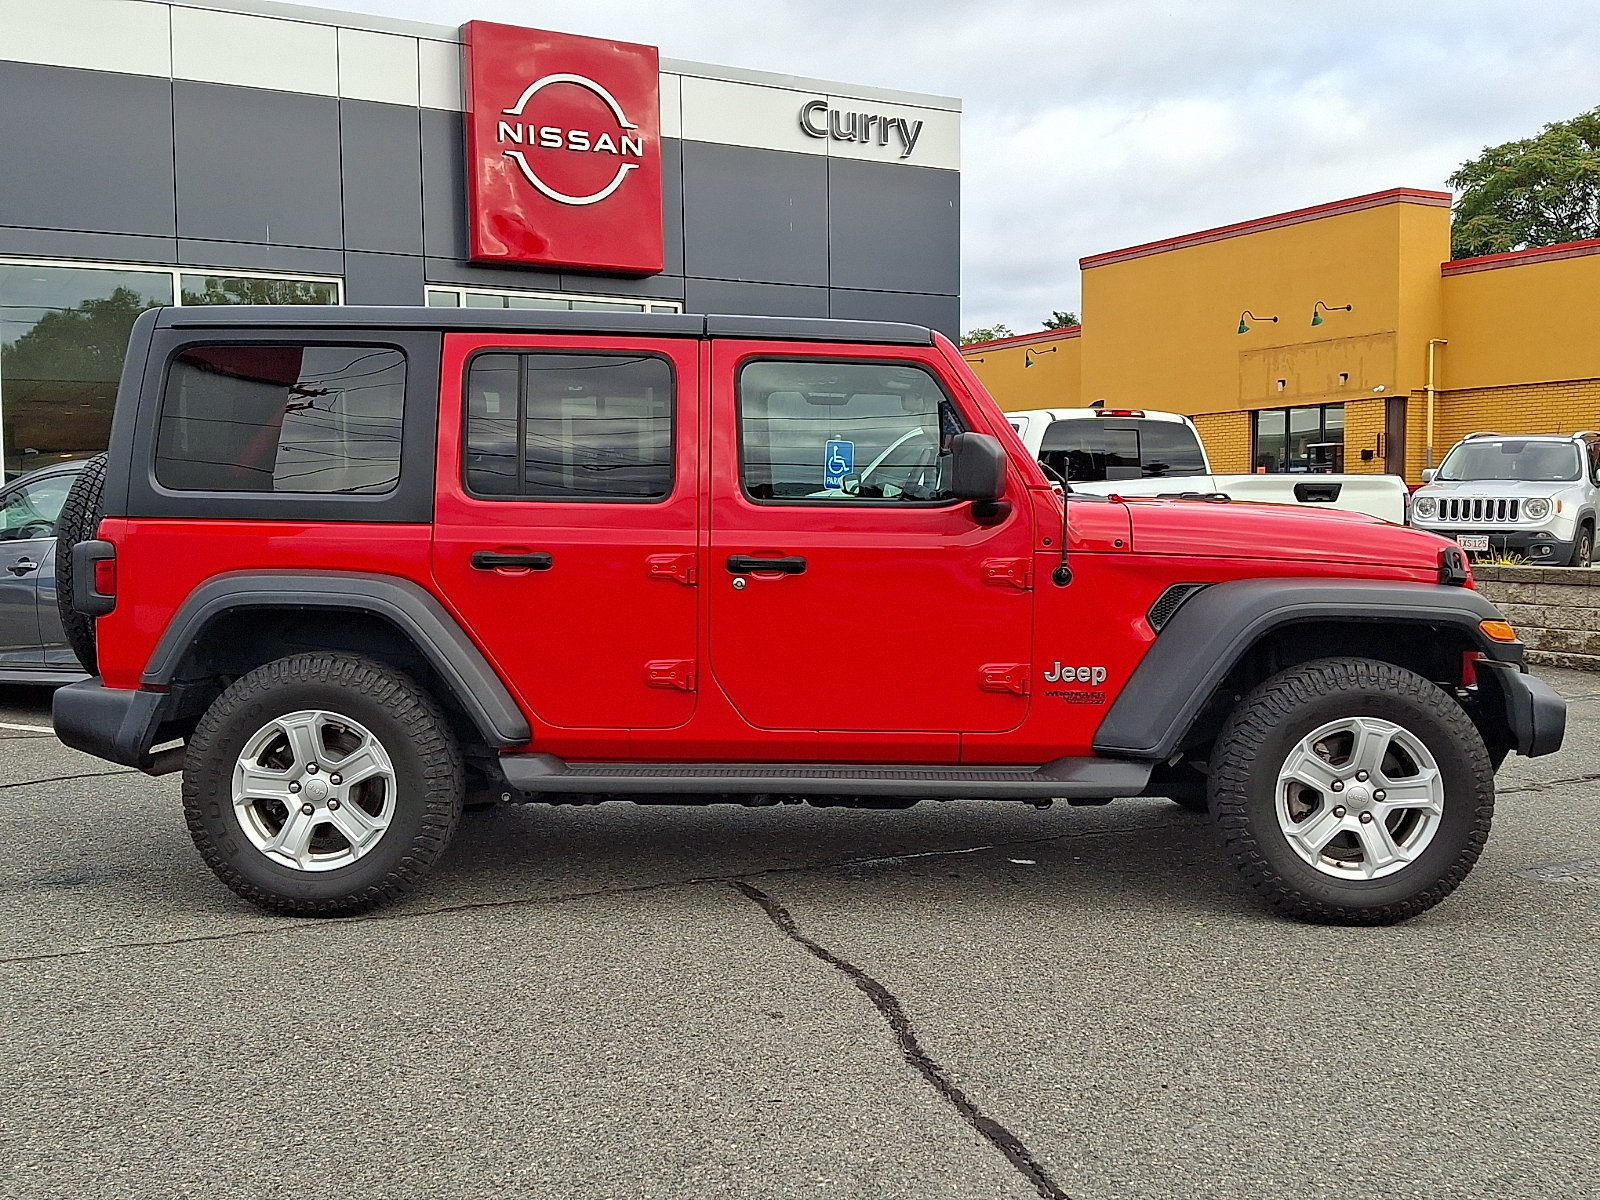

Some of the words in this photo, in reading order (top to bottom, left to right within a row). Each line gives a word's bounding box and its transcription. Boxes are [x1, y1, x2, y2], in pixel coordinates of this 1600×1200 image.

[498, 120, 644, 158] NISSAN
[799, 99, 924, 158] Curry
[1473, 539, 1487, 548] 125
[1043, 661, 1107, 686] Jeep
